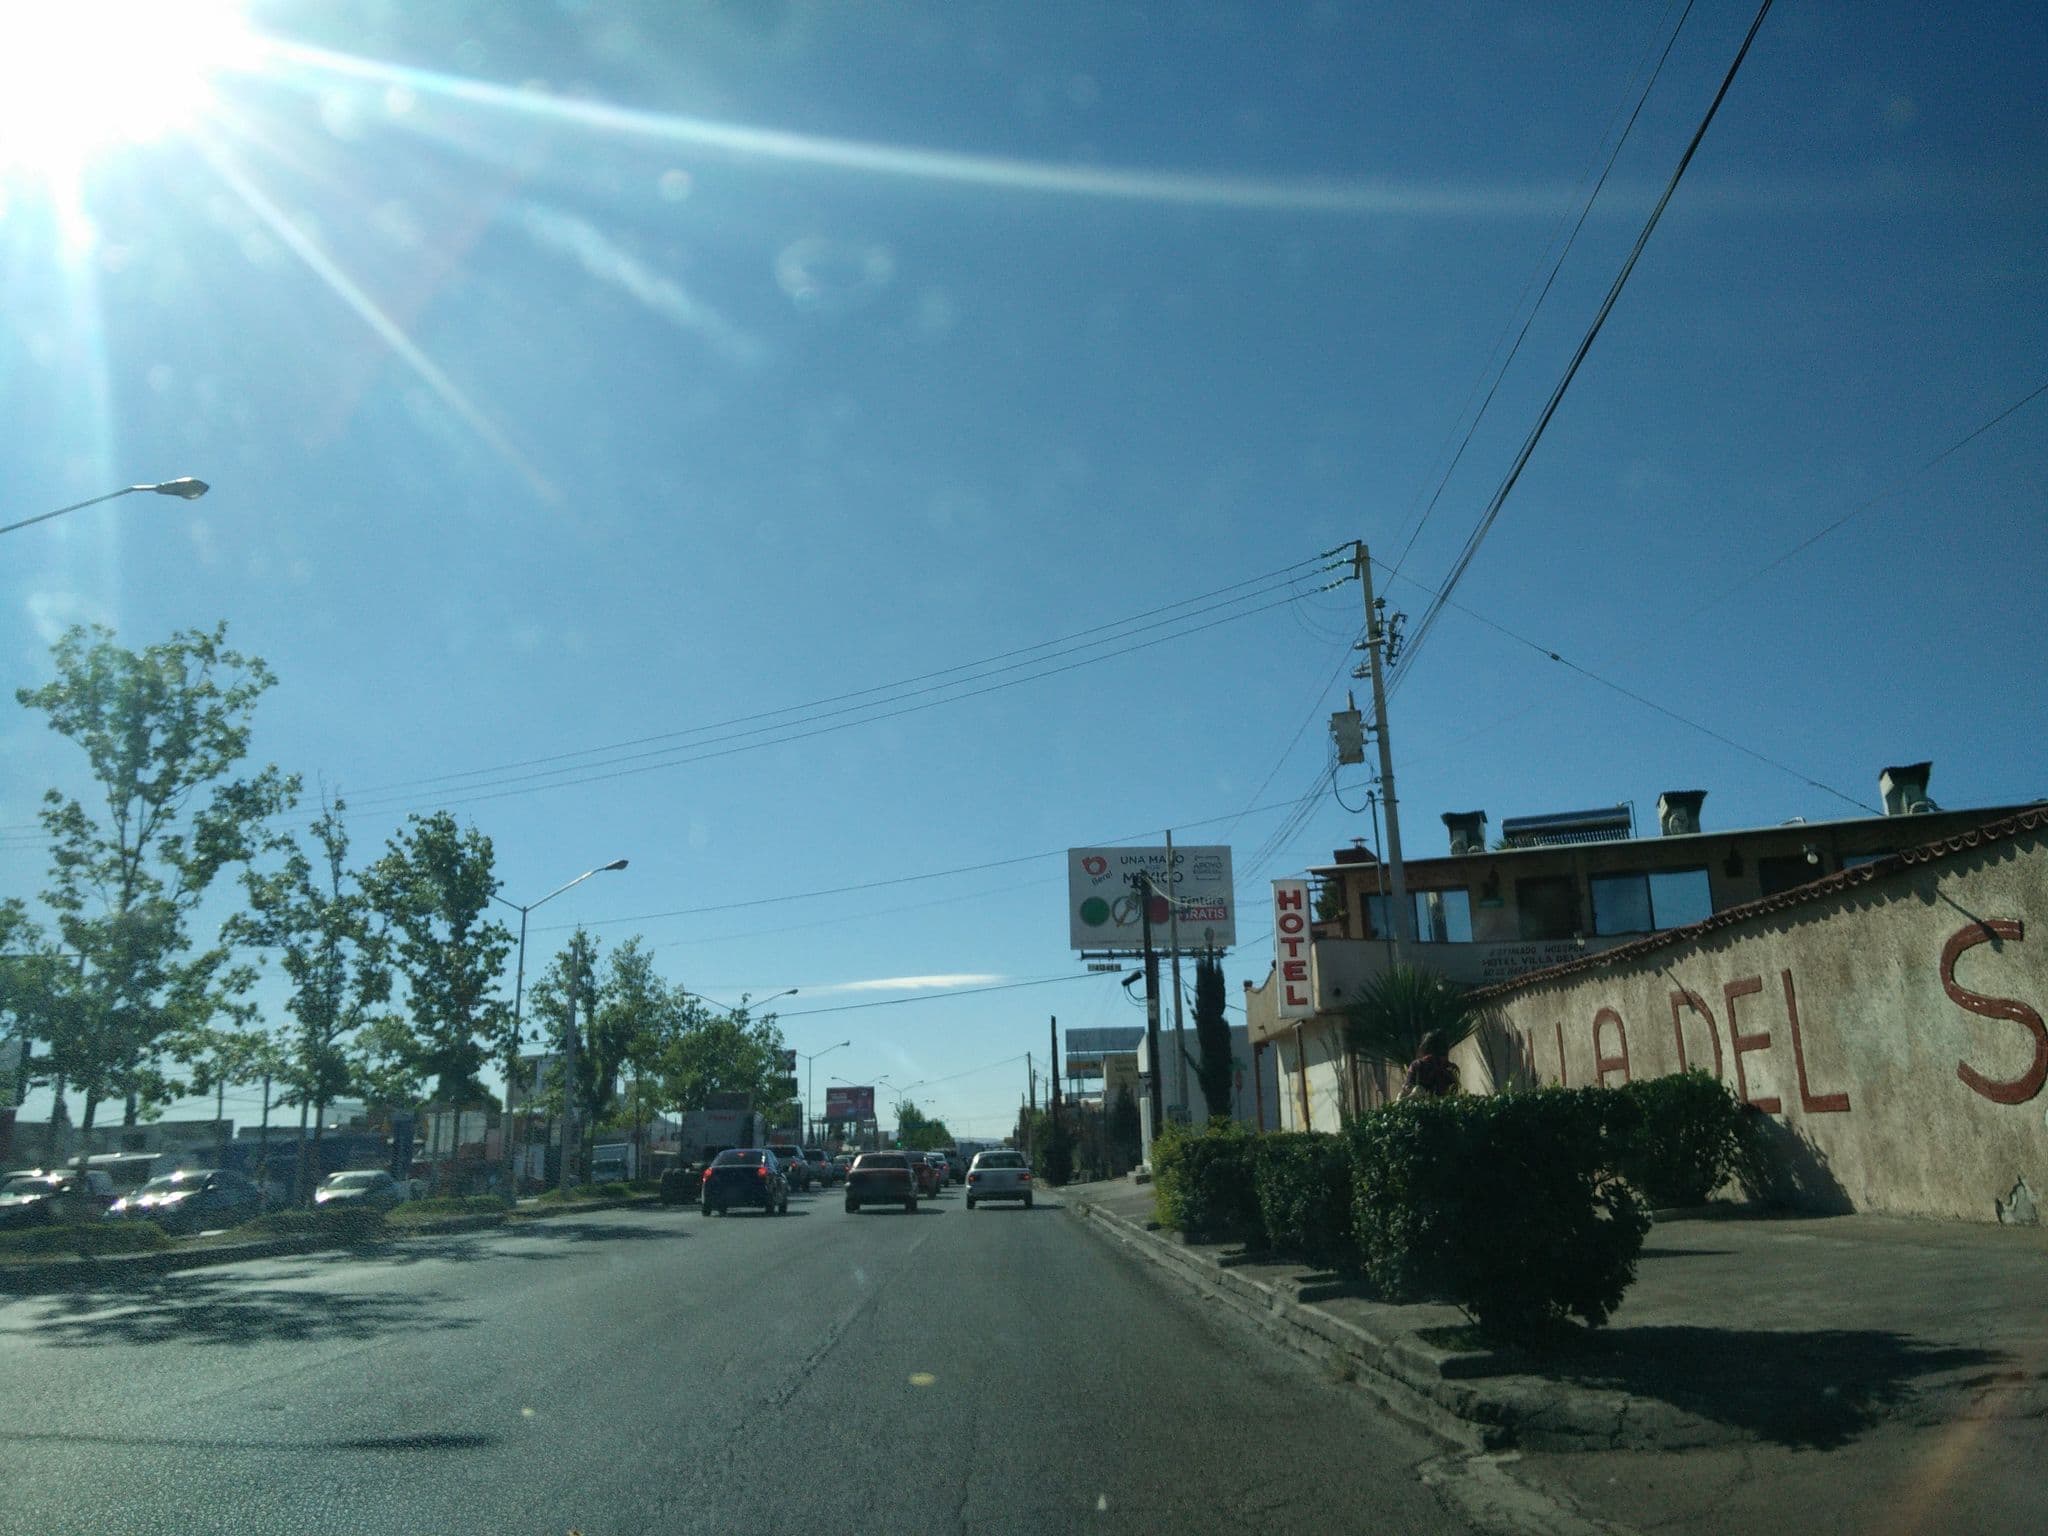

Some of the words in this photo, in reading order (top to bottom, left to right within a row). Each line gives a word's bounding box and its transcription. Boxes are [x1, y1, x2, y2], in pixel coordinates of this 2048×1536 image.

[1120, 855, 1146, 865] UNA
[1148, 854, 1185, 864] MAO
[1123, 871, 1184, 884] MXICO
[1277, 889, 1309, 1006] HOTEL
[1521, 954, 1554, 965] VILLA
[1670, 968, 1851, 1114] DEL
